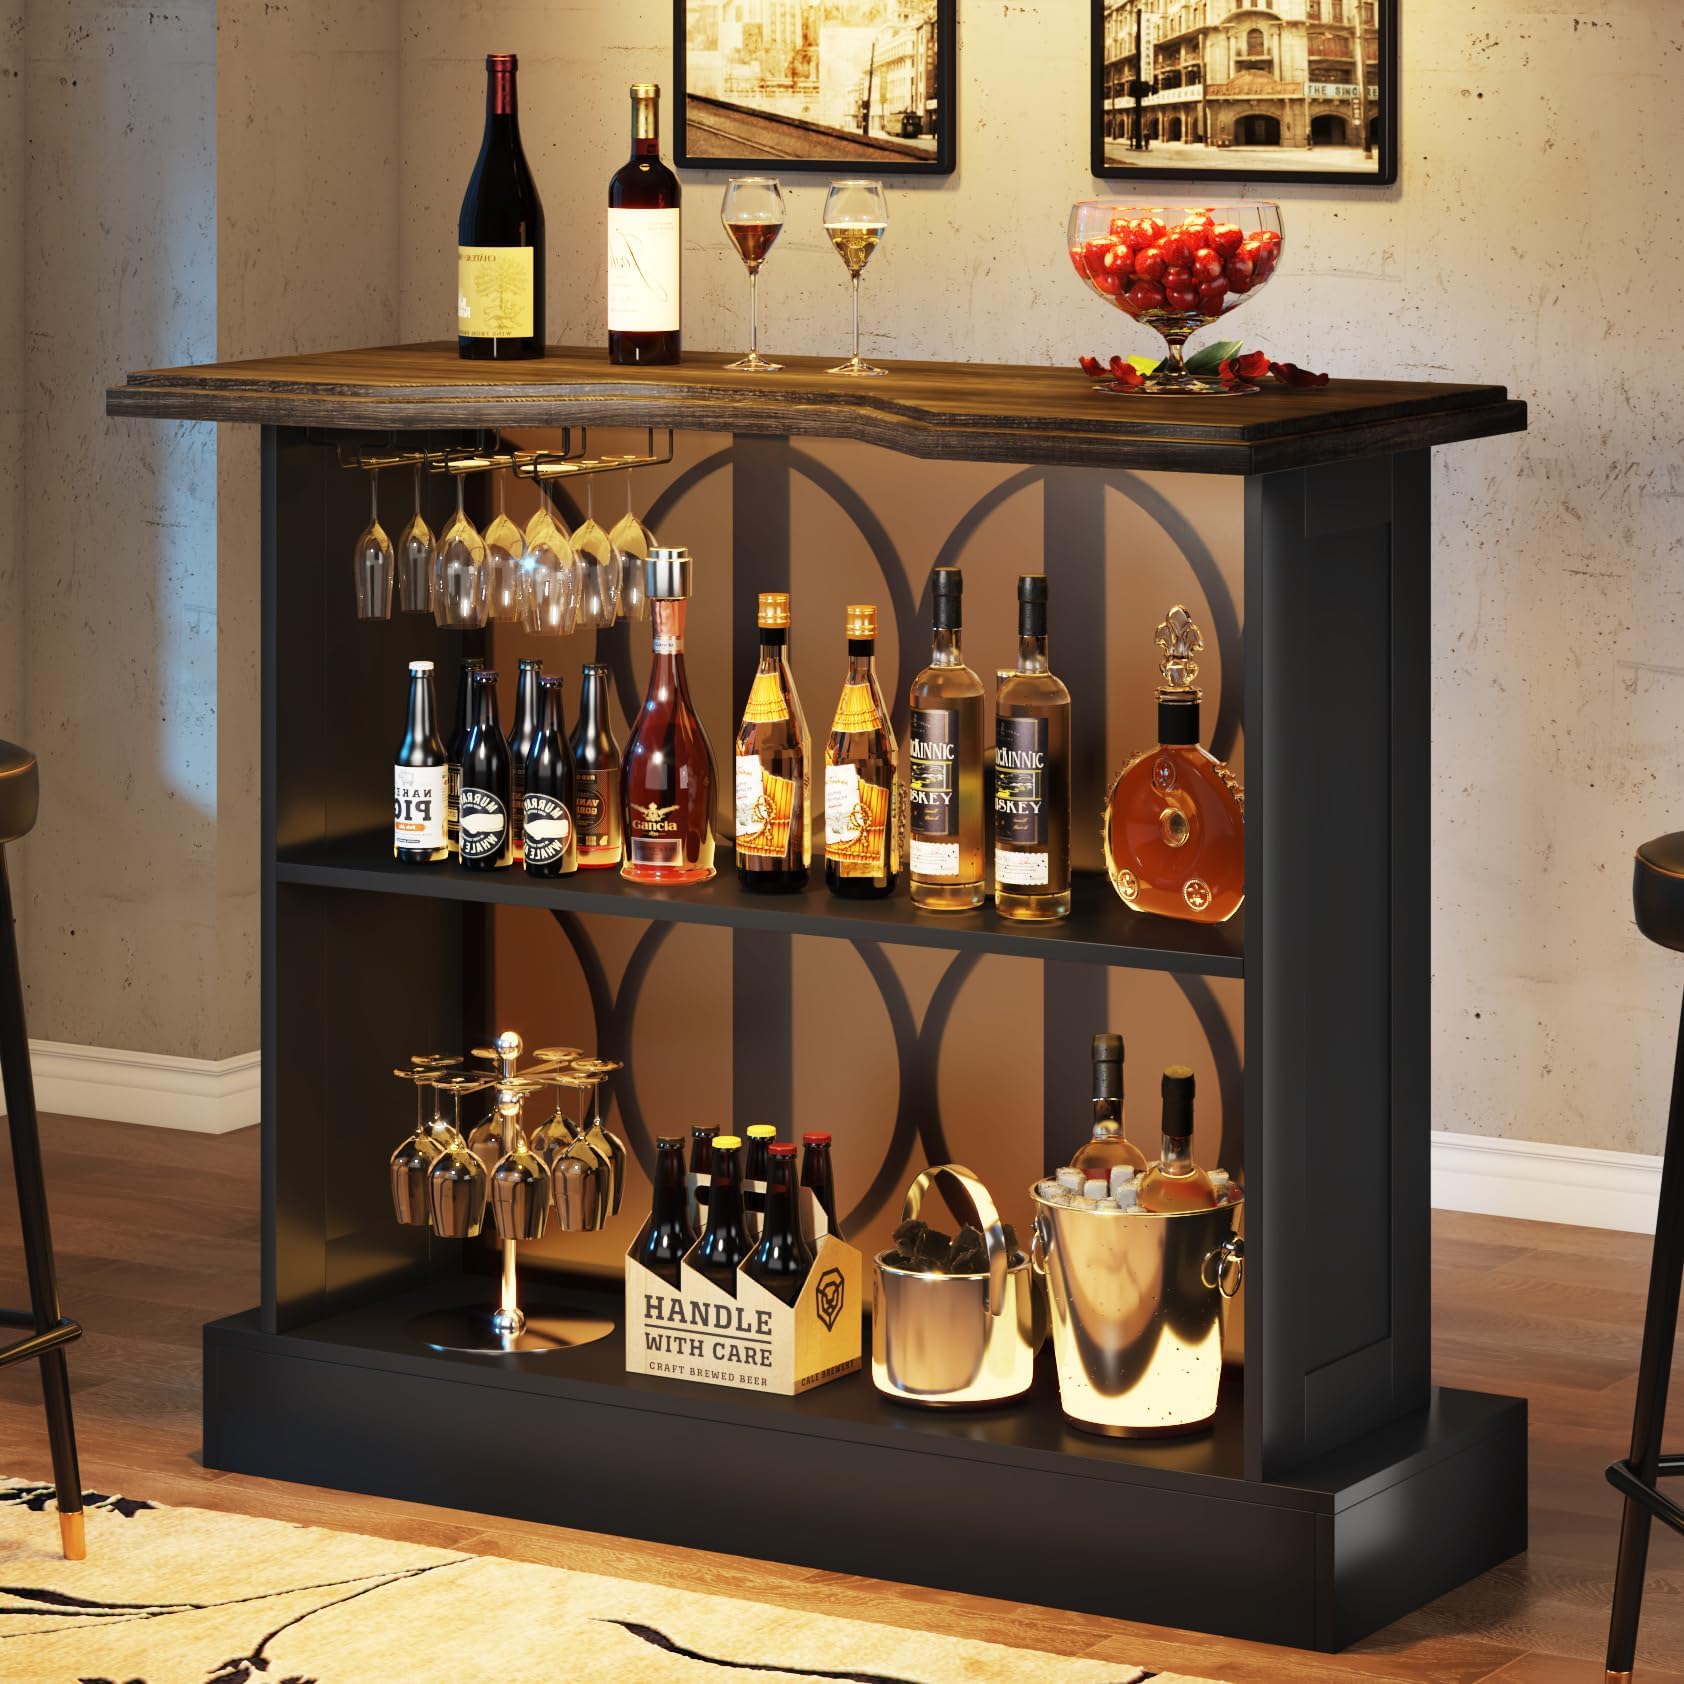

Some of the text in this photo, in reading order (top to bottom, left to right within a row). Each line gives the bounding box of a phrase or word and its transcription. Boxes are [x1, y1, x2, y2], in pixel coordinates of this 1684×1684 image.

[1308, 85, 1327, 96] THE
[1335, 86, 1377, 98] SINCRE
[632, 819, 678, 831] Gancia
[644, 1294, 772, 1336] HANDLE
[645, 1332, 772, 1367] WITH CARE
[649, 1361, 768, 1386] CRAFT BREWED BEER
